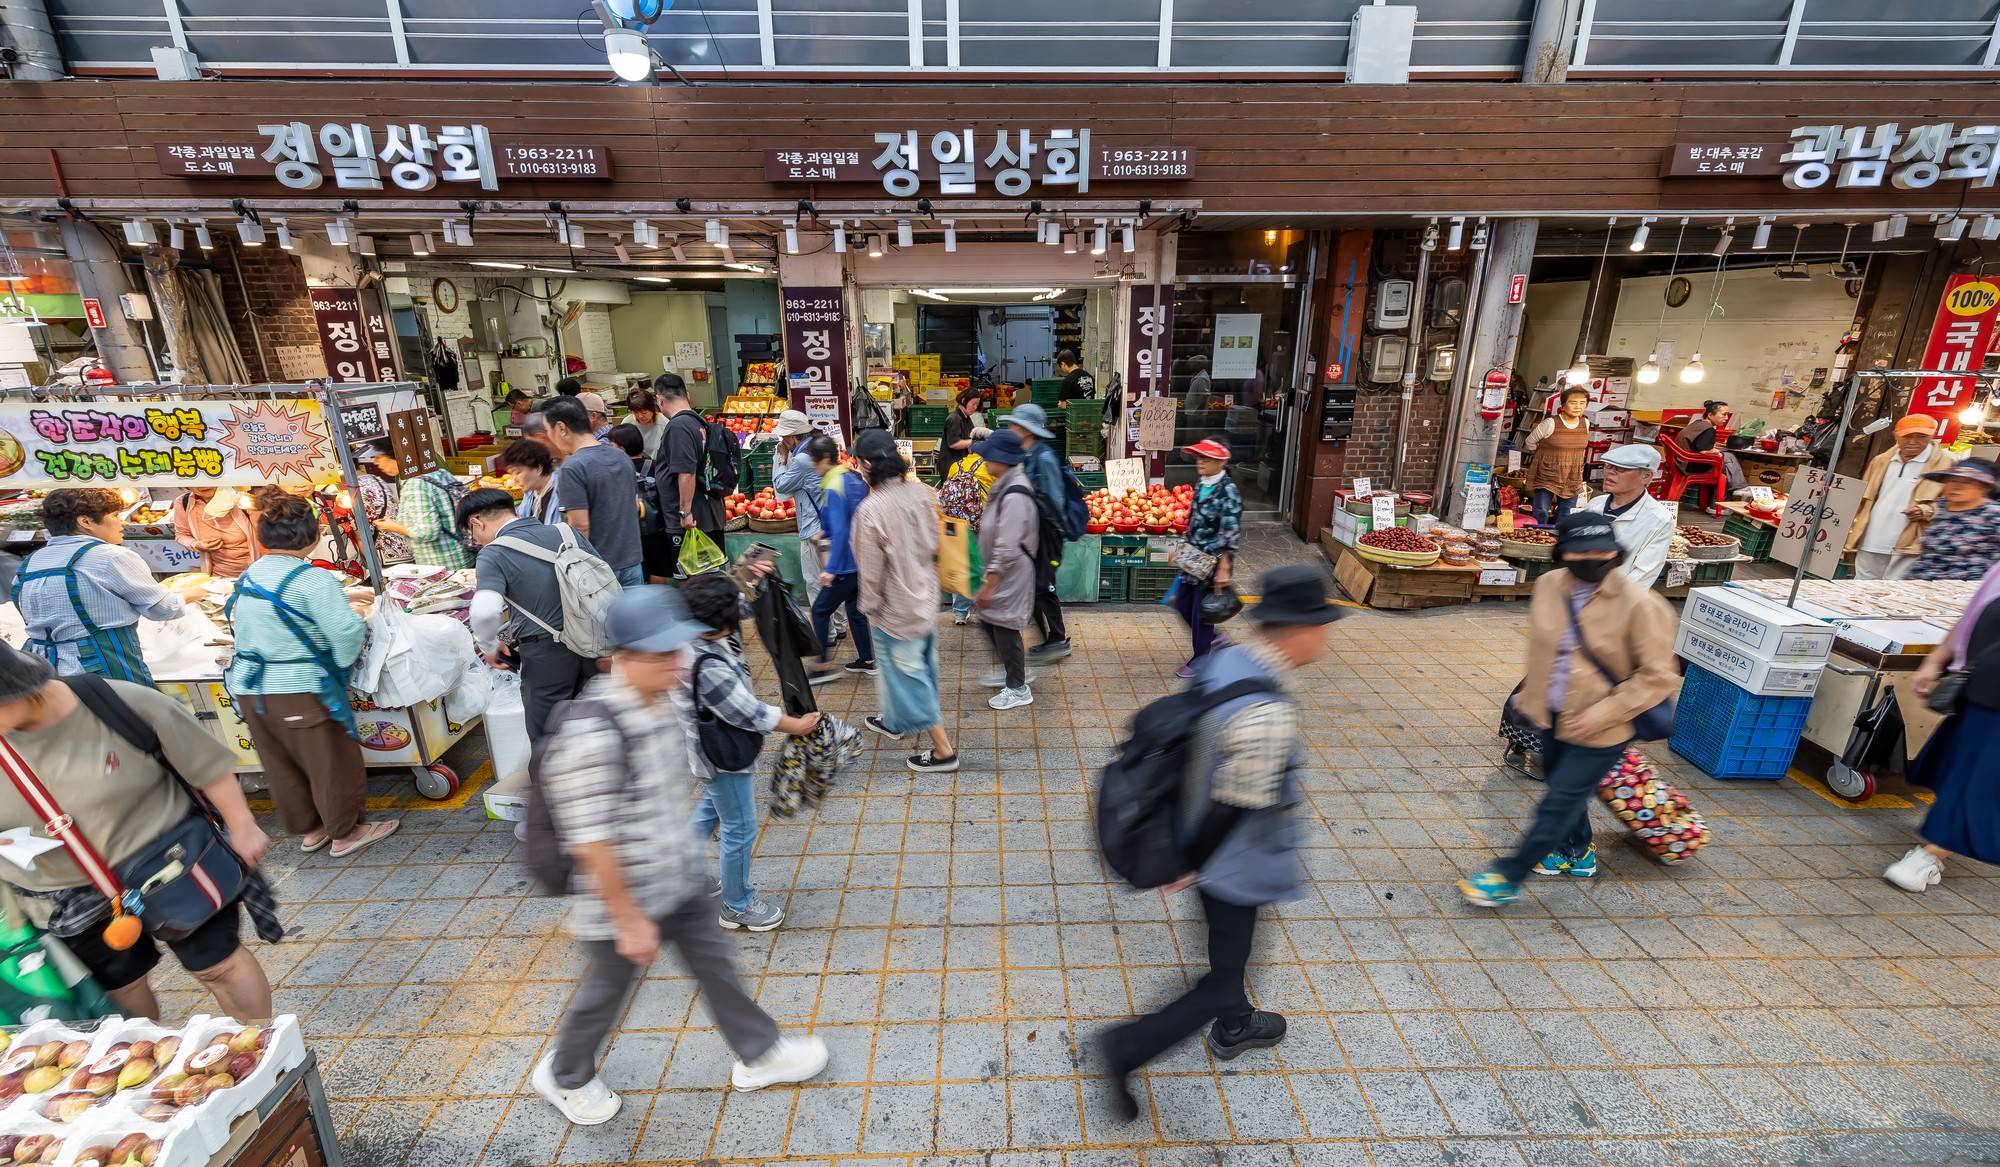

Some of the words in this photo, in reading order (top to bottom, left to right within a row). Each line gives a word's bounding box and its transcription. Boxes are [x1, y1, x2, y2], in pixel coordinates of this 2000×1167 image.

[185, 161, 235, 174] 도소매
[257, 121, 499, 191] 정일상회
[789, 167, 836, 179] 도소매
[871, 128, 1091, 197] 정일상회
[1696, 161, 1745, 174] 도소매
[1779, 122, 2000, 190] 광남상회
[313, 301, 358, 311] 963-2211
[786, 299, 840, 309] 963-2211
[1951, 289, 1995, 308] 100%
[144, 407, 208, 443] 행복
[242, 422, 267, 433] 오늘도
[397, 418, 413, 464] 옥수수
[416, 415, 431, 459] 단호박
[35, 449, 119, 482] 건강한
[117, 447, 175, 481] 수제
[171, 446, 227, 481] 술빵
[1699, 602, 1759, 636] 명태포슬라이스
[1690, 636, 1747, 670] 명태포슬라이스
